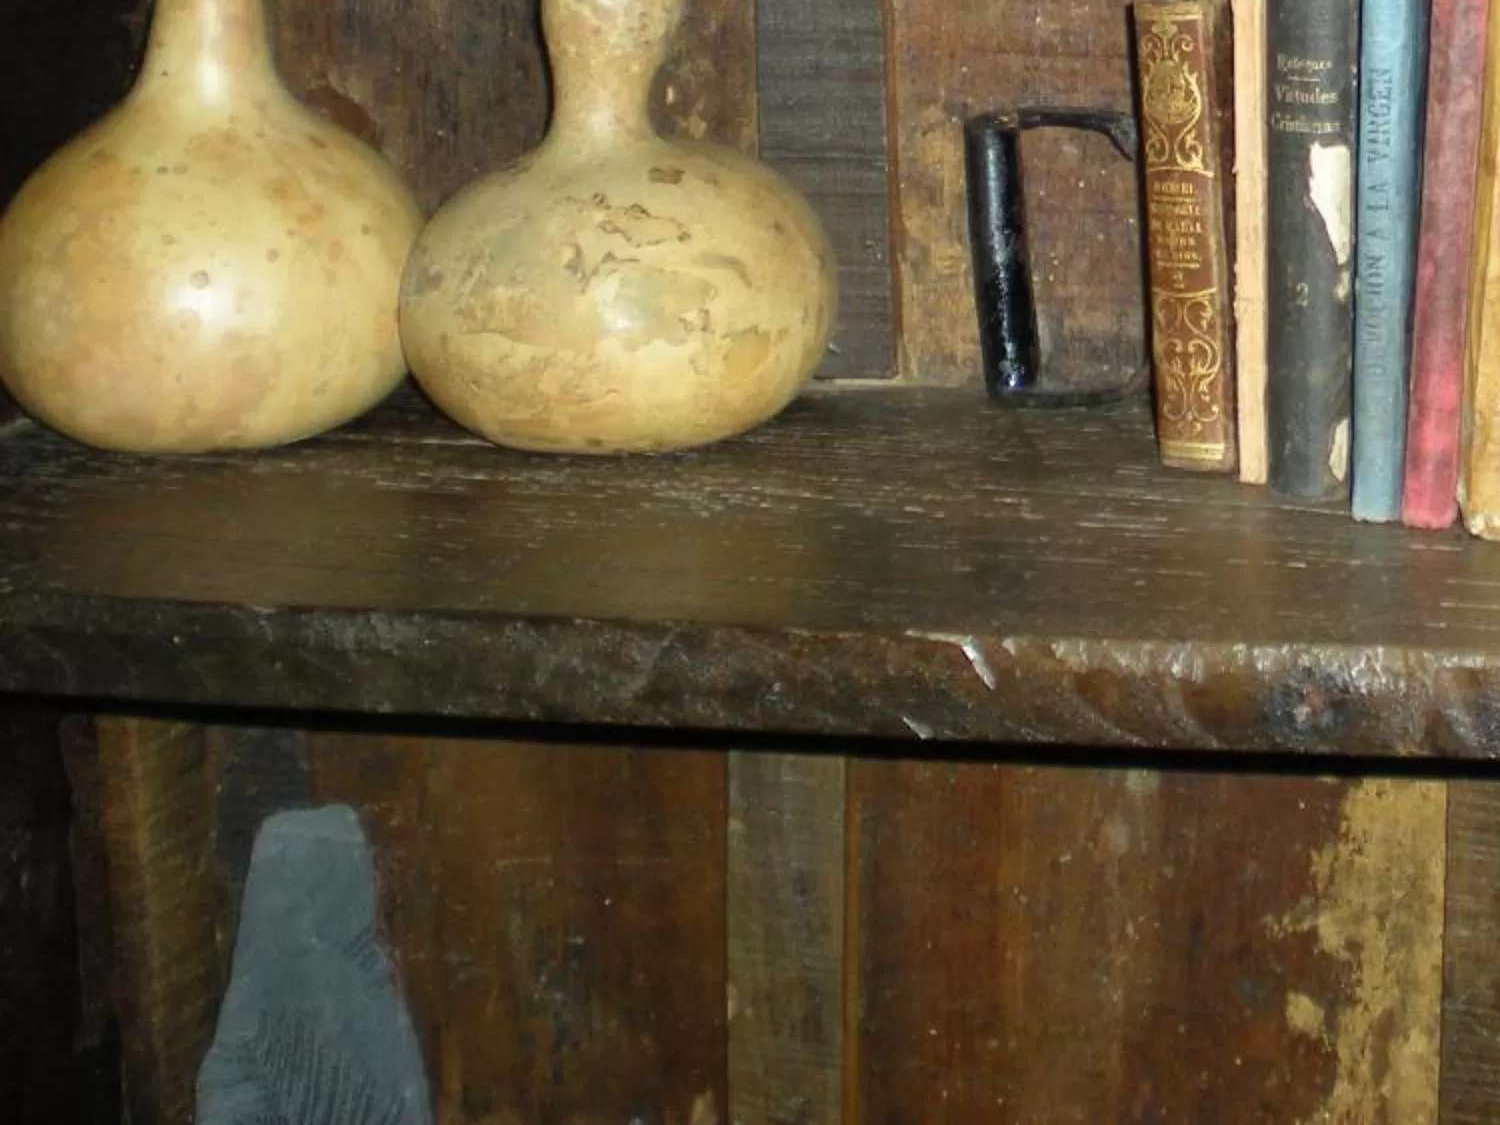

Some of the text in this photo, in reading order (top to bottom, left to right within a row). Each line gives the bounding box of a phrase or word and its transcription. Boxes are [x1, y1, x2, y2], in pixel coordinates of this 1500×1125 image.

[1366, 66, 1393, 167] VIRGEN
[1366, 182, 1390, 212] LA
[1295, 282, 1309, 308] 2
[1362, 254, 1387, 377] DVOCION
